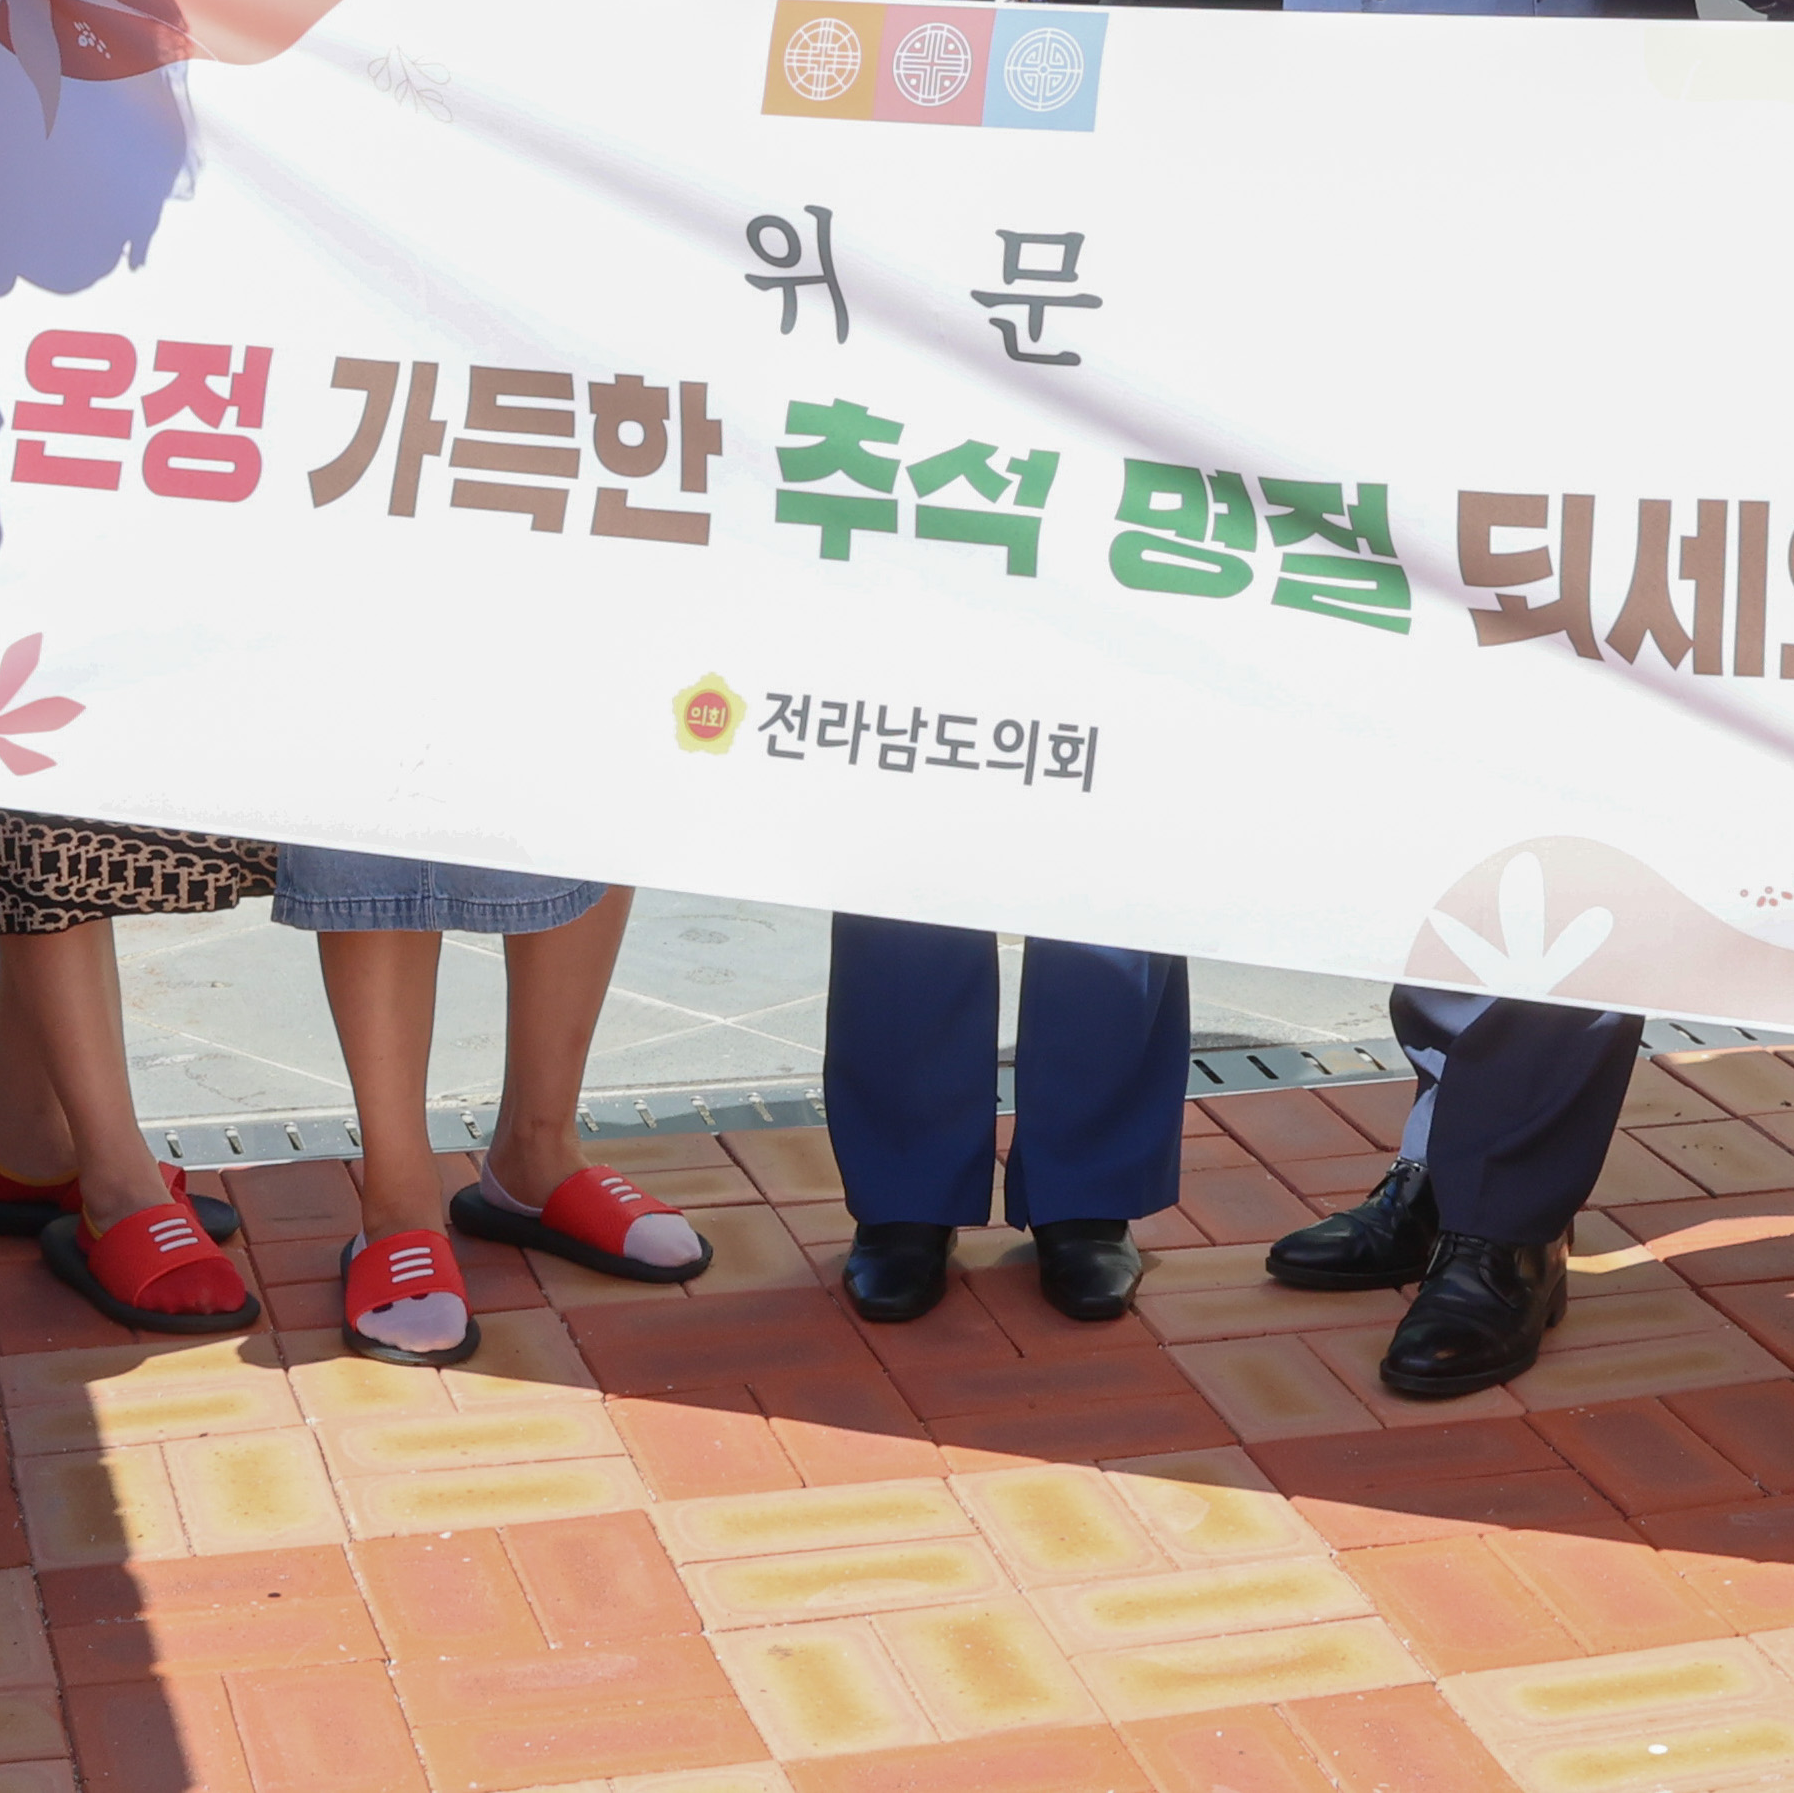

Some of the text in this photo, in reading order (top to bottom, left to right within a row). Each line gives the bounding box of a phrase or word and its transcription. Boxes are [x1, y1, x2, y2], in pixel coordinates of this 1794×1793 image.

[745, 205, 1104, 367] 위 문
[10, 329, 274, 504] 온정
[307, 355, 724, 547] 가득한
[774, 398, 1062, 579] 추석
[1107, 457, 1413, 636] 명절
[687, 706, 727, 729] 의회
[757, 692, 1100, 794] 전라남도의회
